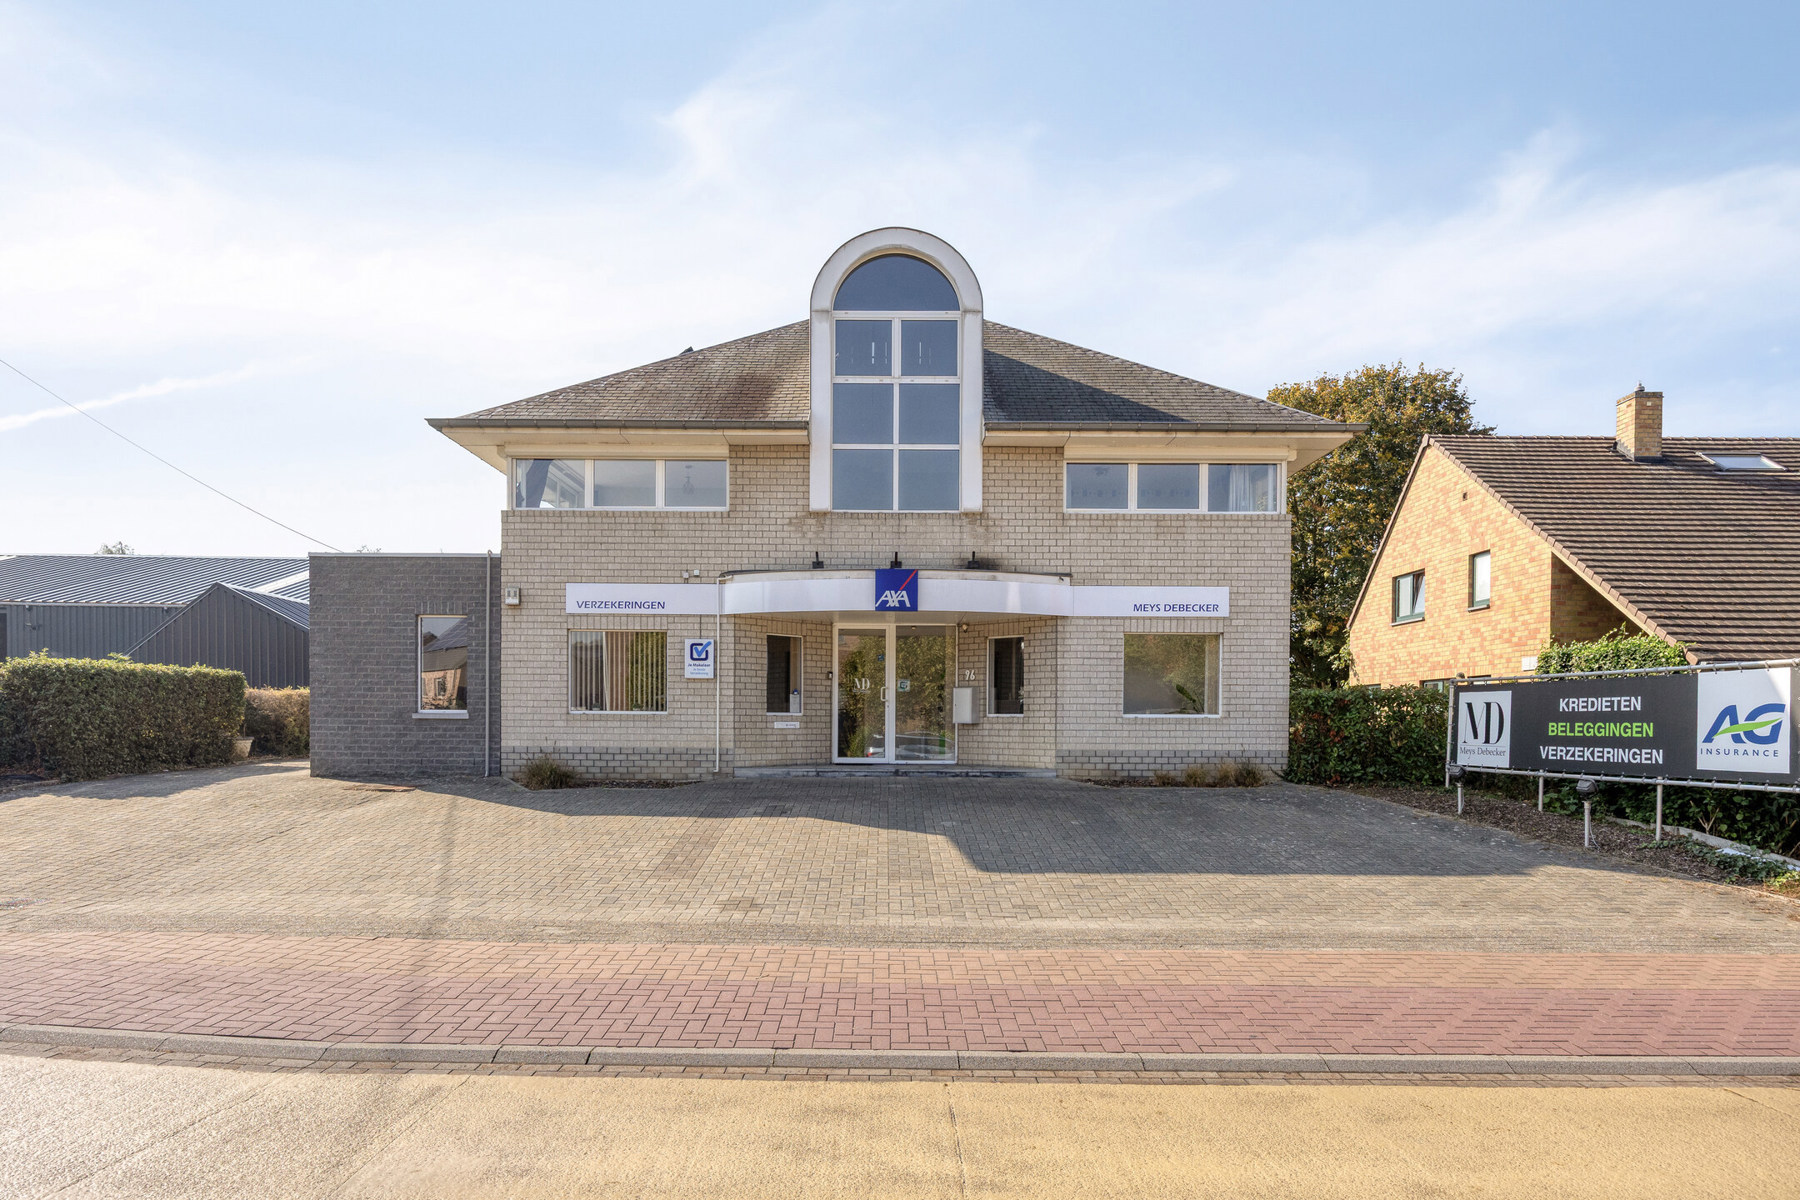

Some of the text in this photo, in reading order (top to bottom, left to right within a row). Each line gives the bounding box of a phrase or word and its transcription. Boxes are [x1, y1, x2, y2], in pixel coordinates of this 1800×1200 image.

[576, 600, 666, 610] VERZEKERINGEN
[875, 590, 911, 607] AXA
[1133, 603, 1219, 612] MEYS DEBECKER
[964, 669, 976, 681] 96
[1559, 696, 1642, 712] KREDIETEN
[1548, 722, 1654, 737] BELEGGINGEN
[1702, 703, 1786, 745] AG
[1460, 747, 1506, 759] Meys Debecker
[1539, 745, 1663, 764] VERZEKERINGEN
[1700, 748, 1779, 757] INSURANCE
